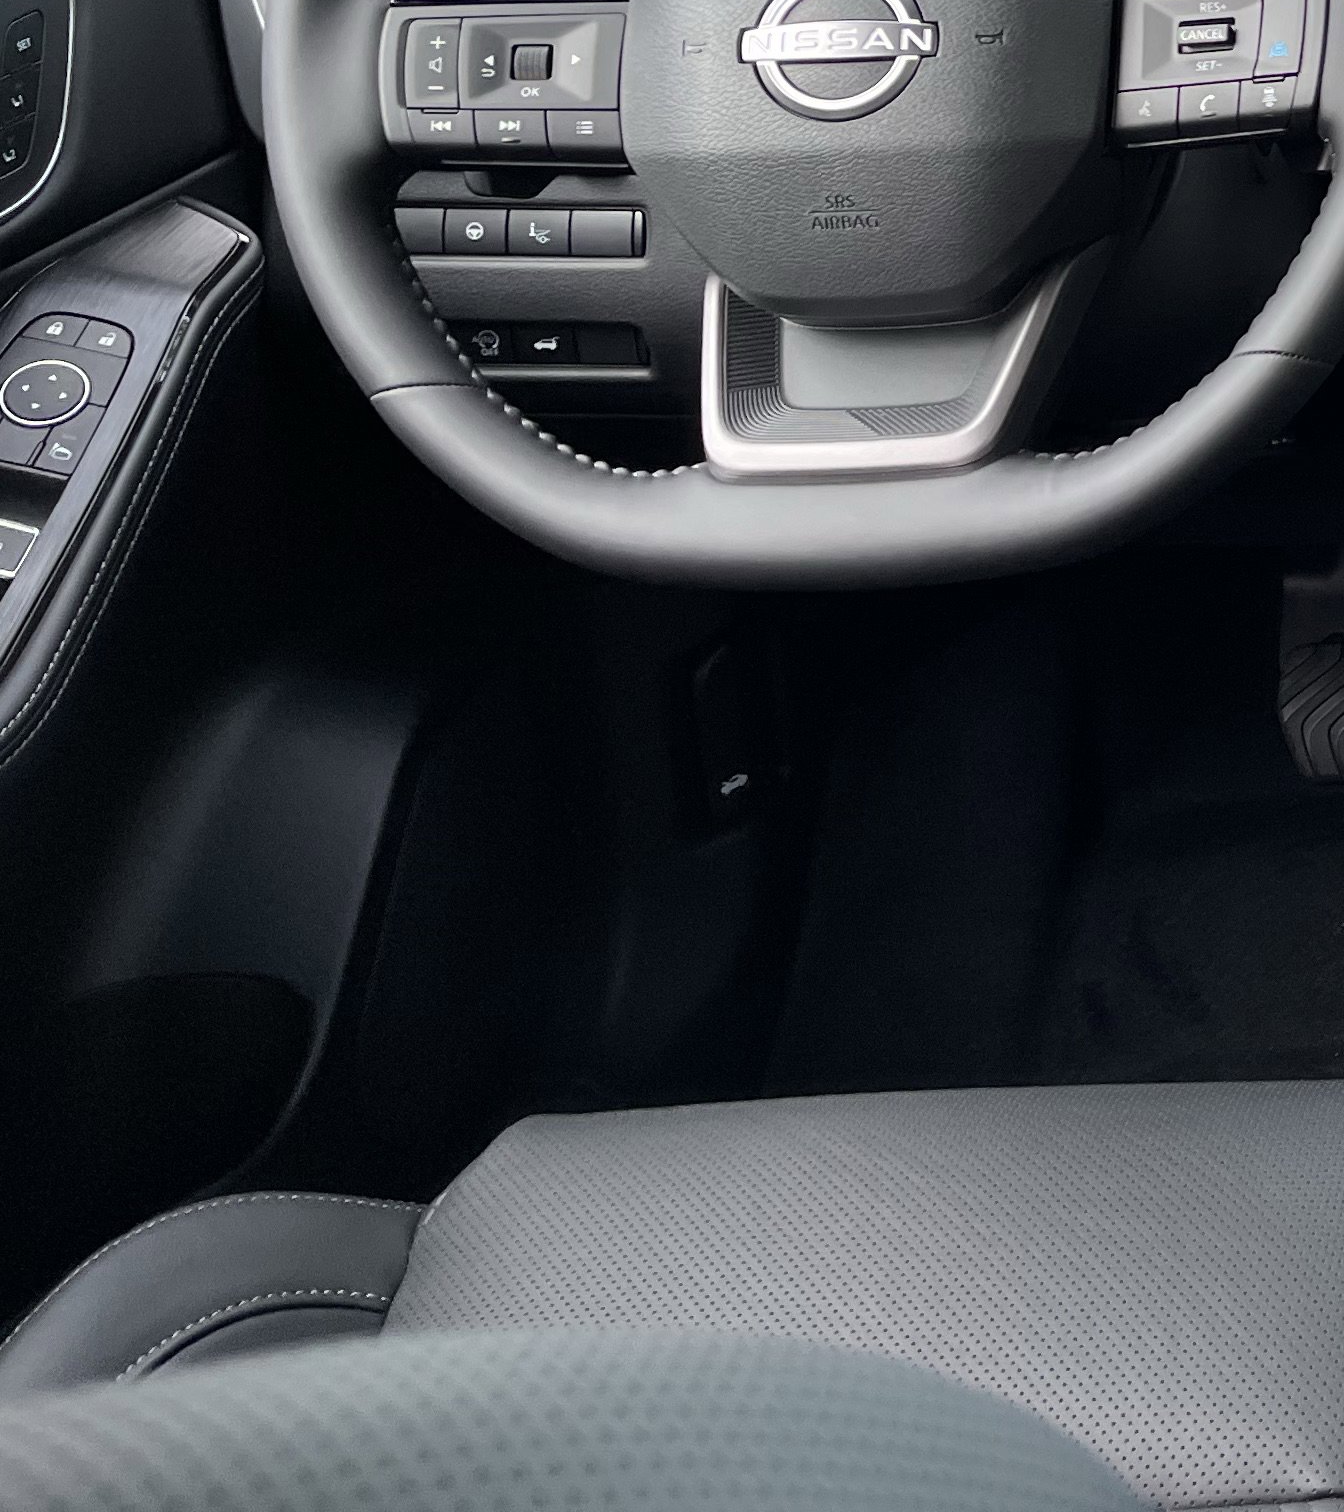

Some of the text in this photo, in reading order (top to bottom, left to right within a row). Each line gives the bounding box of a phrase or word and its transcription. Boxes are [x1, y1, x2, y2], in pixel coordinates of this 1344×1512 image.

[748, 27, 932, 55] NISSAN
[1180, 28, 1225, 41] CANCEL
[520, 86, 540, 97] OK
[824, 194, 856, 210] SRS
[811, 214, 880, 231] AIRBAG
